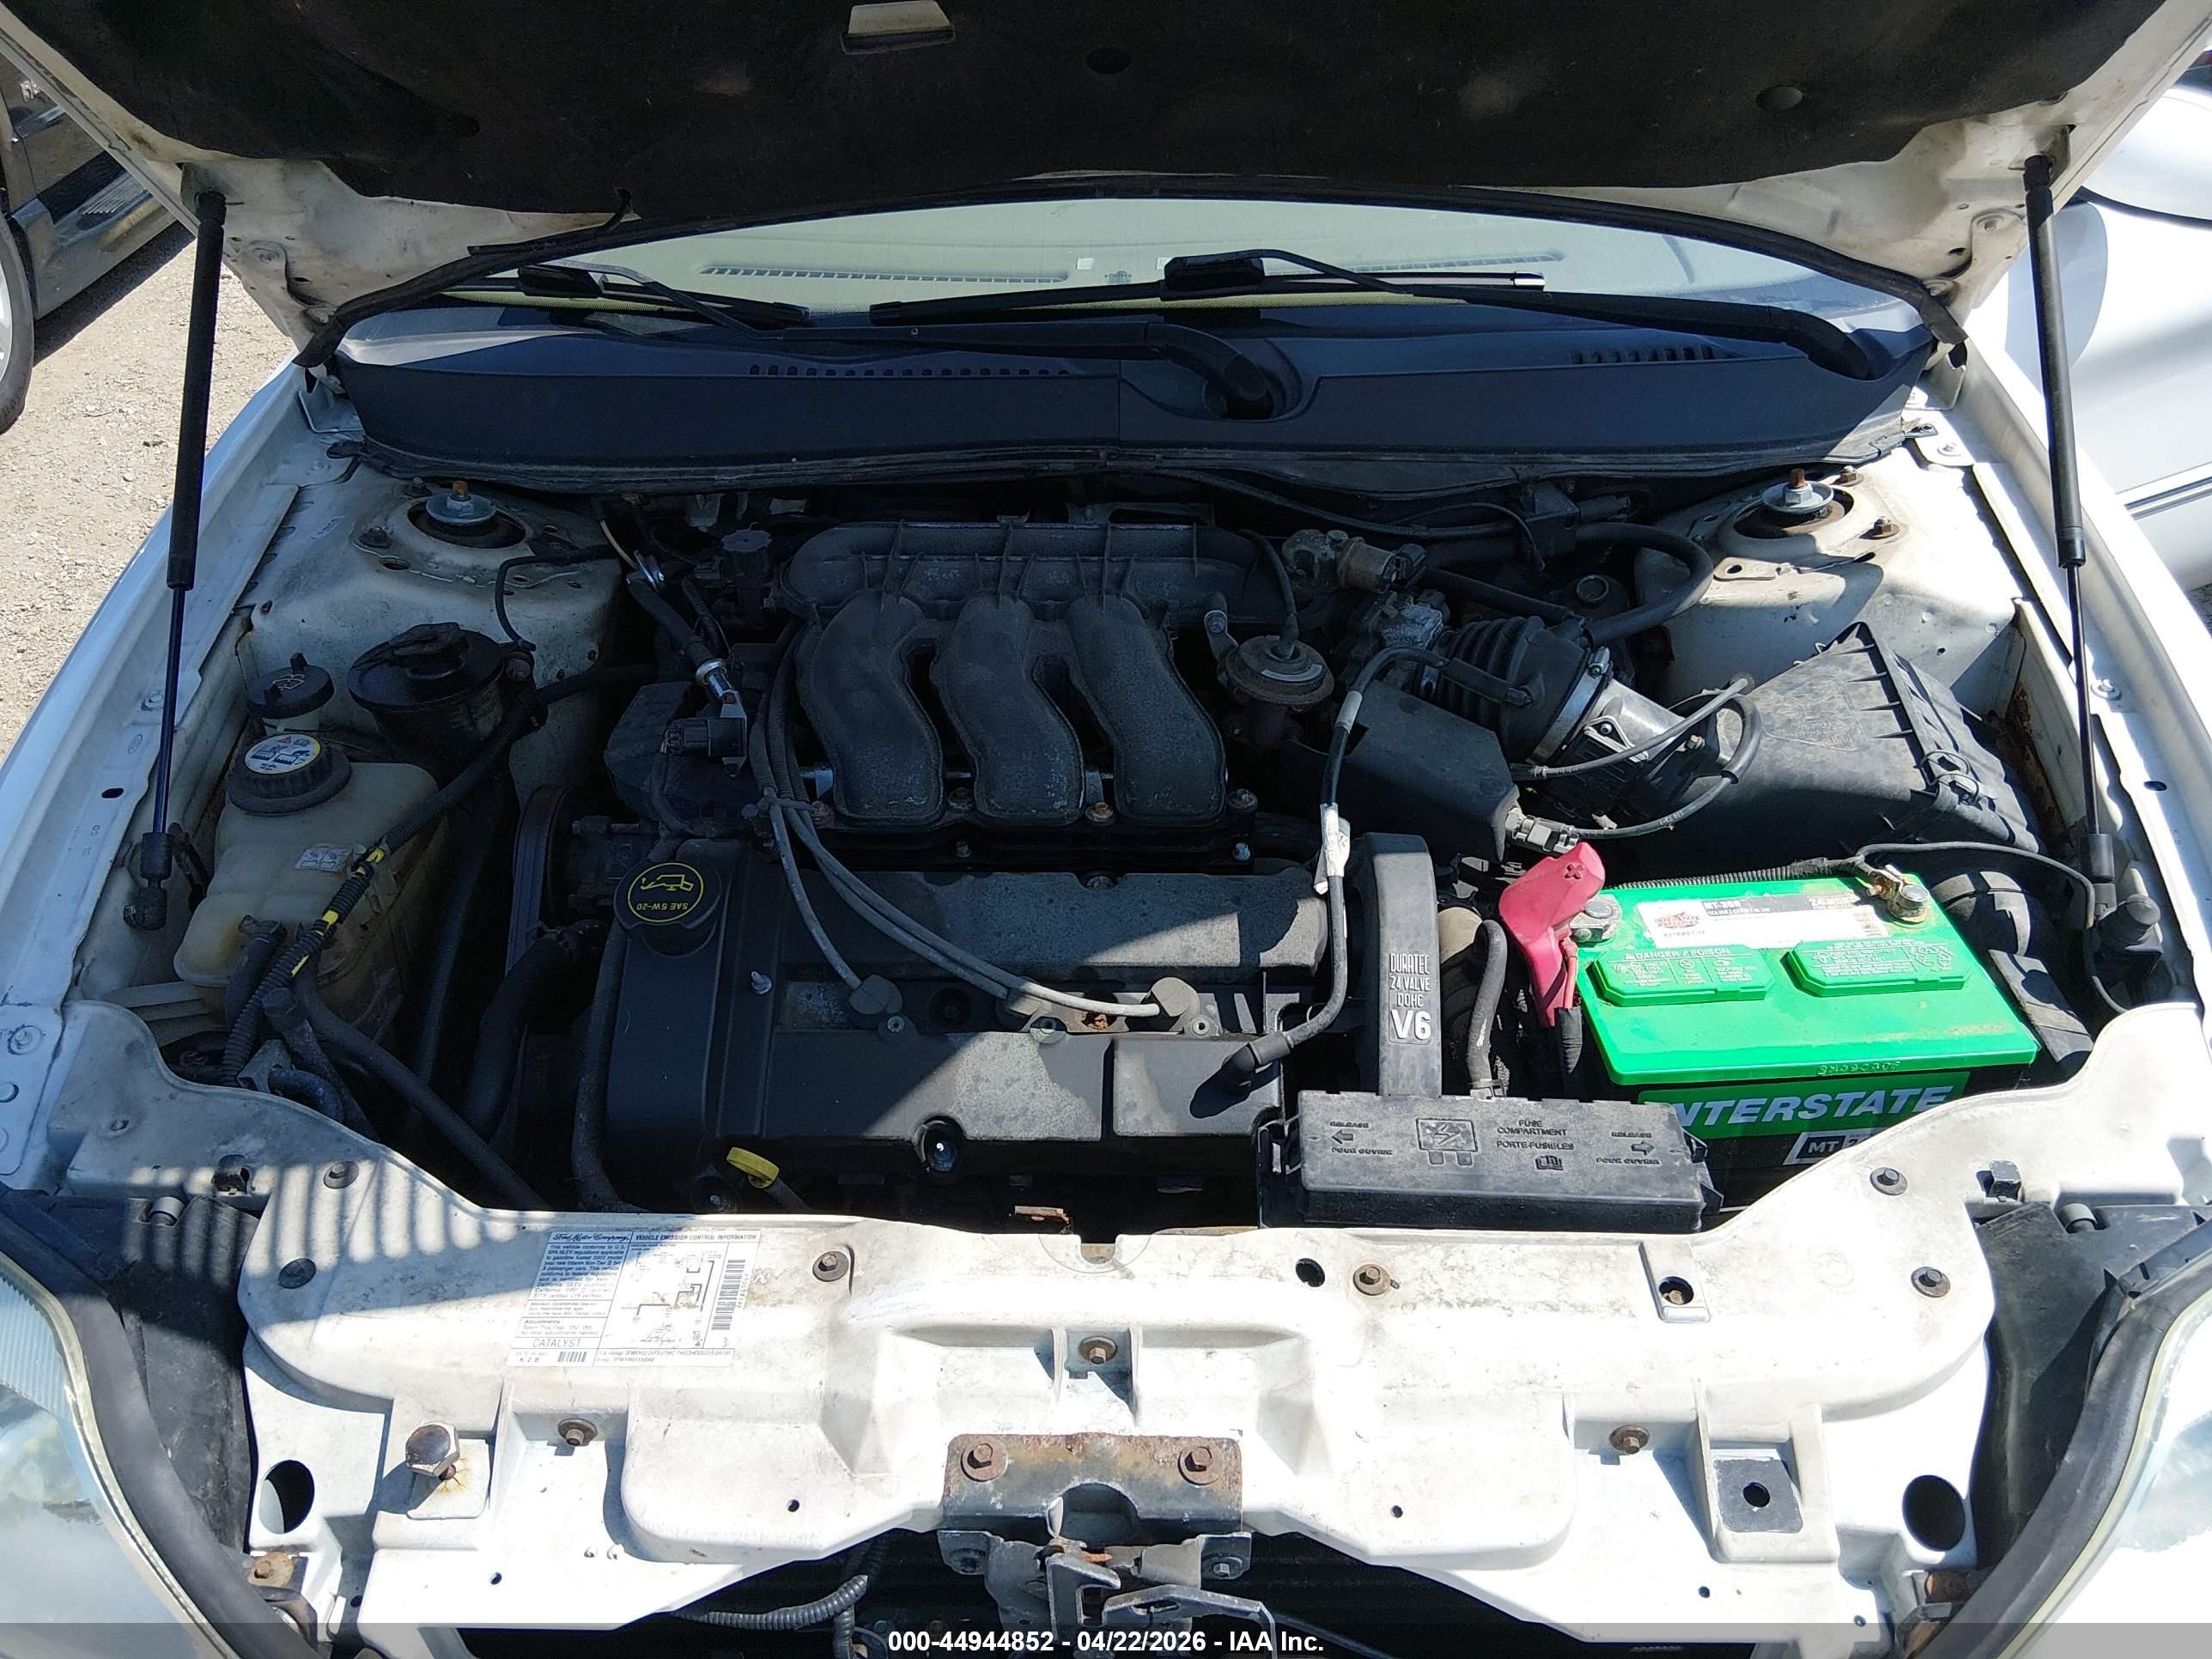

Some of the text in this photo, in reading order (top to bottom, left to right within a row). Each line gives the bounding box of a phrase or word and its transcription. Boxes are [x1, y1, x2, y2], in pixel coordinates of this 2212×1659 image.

[1633, 951, 1679, 960] DANGER
[1690, 948, 1731, 957] POISON
[1389, 952, 1431, 975] DURATEC
[1390, 976, 1431, 992] 24 VALVE
[1396, 993, 1424, 1008] DOHC
[1389, 1010, 1431, 1041] V6
[1669, 1085, 1954, 1127] NTERSTATE
[1497, 1127, 1567, 1136] COMPARTMENT
[1496, 1140, 1575, 1151] PORTE-FUSIBLES
[1808, 1139, 1839, 1154] MT
[532, 1339, 582, 1348] CATALYST
